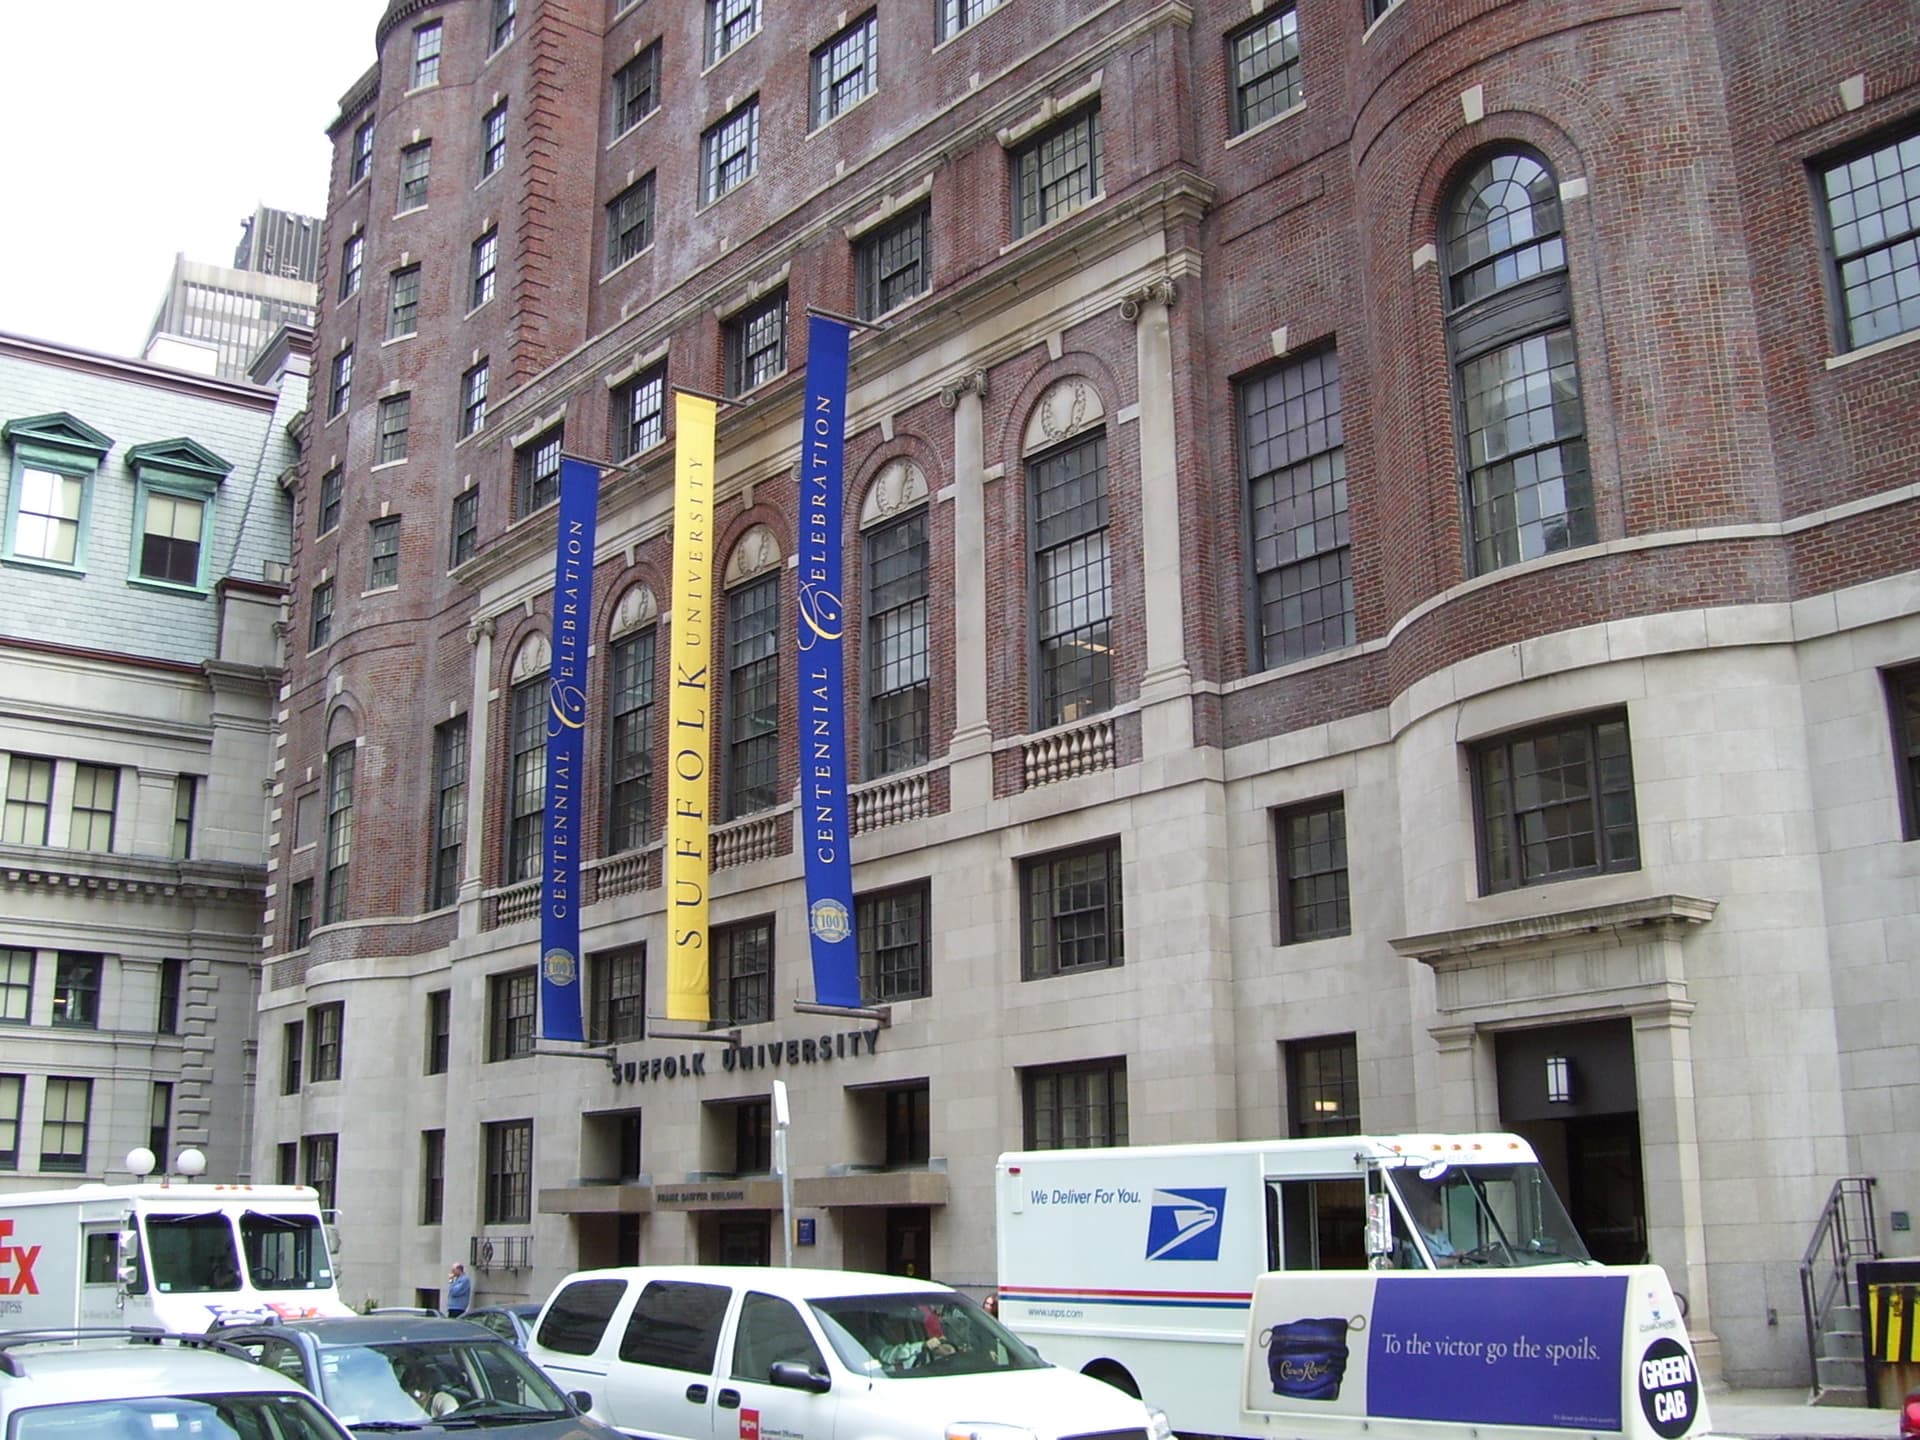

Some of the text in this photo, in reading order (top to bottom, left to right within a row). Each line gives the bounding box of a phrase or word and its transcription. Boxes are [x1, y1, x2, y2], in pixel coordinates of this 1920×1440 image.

[797, 395, 843, 864] CENTENNIAL CELEBRATION
[548, 520, 585, 919] CENTENNIAL CELEBRATION
[675, 457, 708, 949] SUFFOLK UNIVERSITY
[612, 1025, 880, 1086] SUFFOLK UNIVERSITY
[1031, 1188, 1141, 1204] We Deliver For You.
[1028, 1308, 1083, 1319] www.usps.com
[1382, 1333, 1600, 1366] To the victor go the spoils.
[1642, 1355, 1692, 1390] GREEN
[1654, 1390, 1688, 1423] CAB
